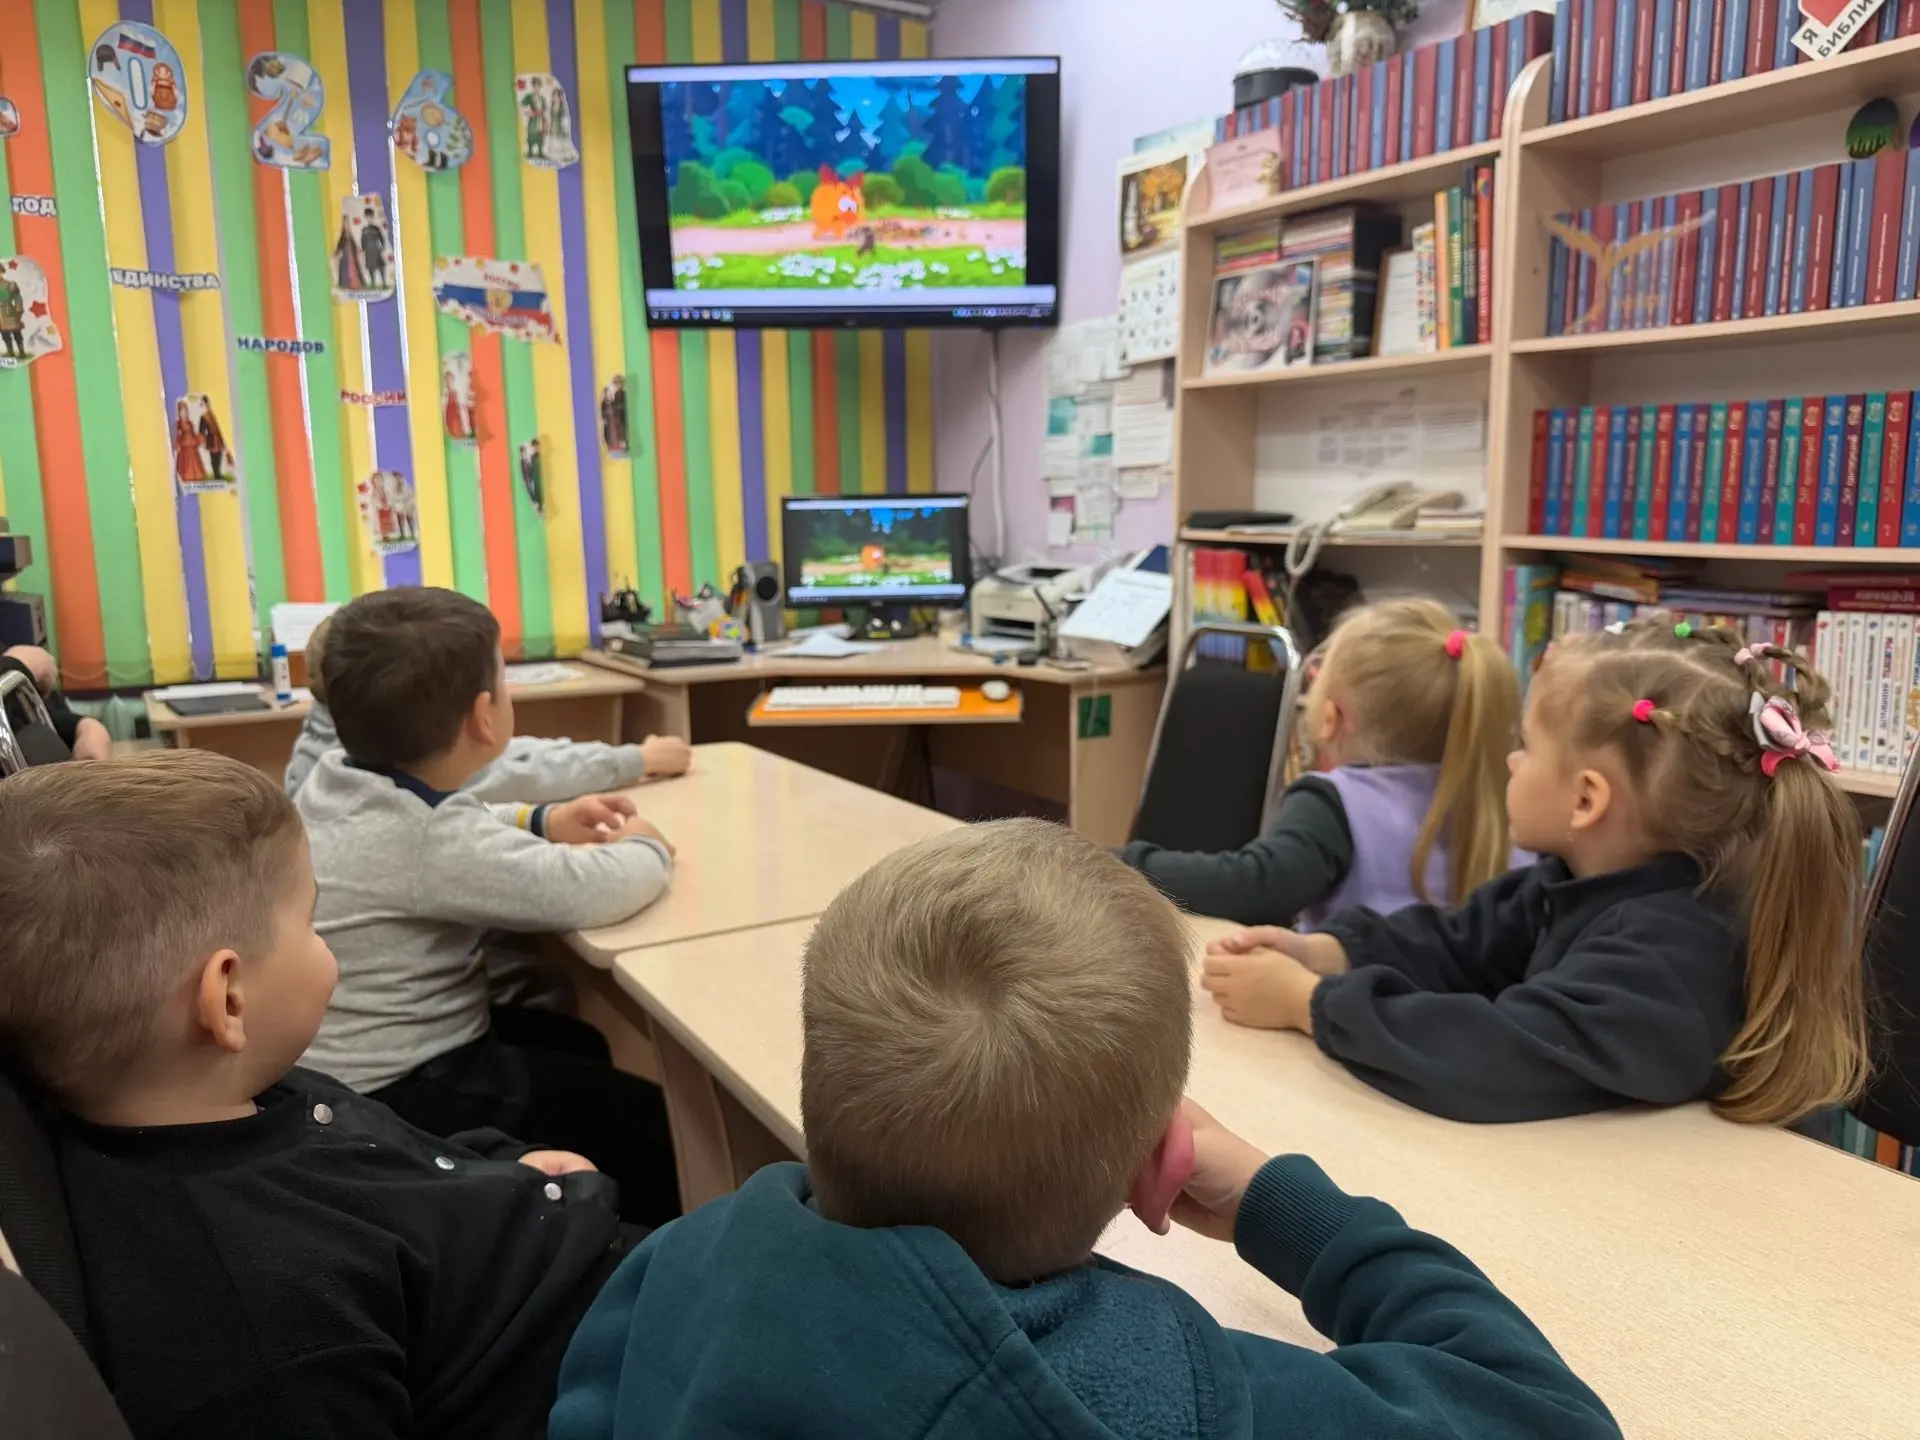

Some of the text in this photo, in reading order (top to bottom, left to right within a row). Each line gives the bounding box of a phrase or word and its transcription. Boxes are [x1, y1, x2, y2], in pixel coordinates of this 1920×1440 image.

[1802, 28, 1819, 45] Я
[246, 51, 331, 170] 2
[392, 68, 473, 172] 6
[11, 196, 58, 216] ГОД
[237, 337, 325, 354] НАРОДОВ
[340, 389, 406, 404] РОССИИ
